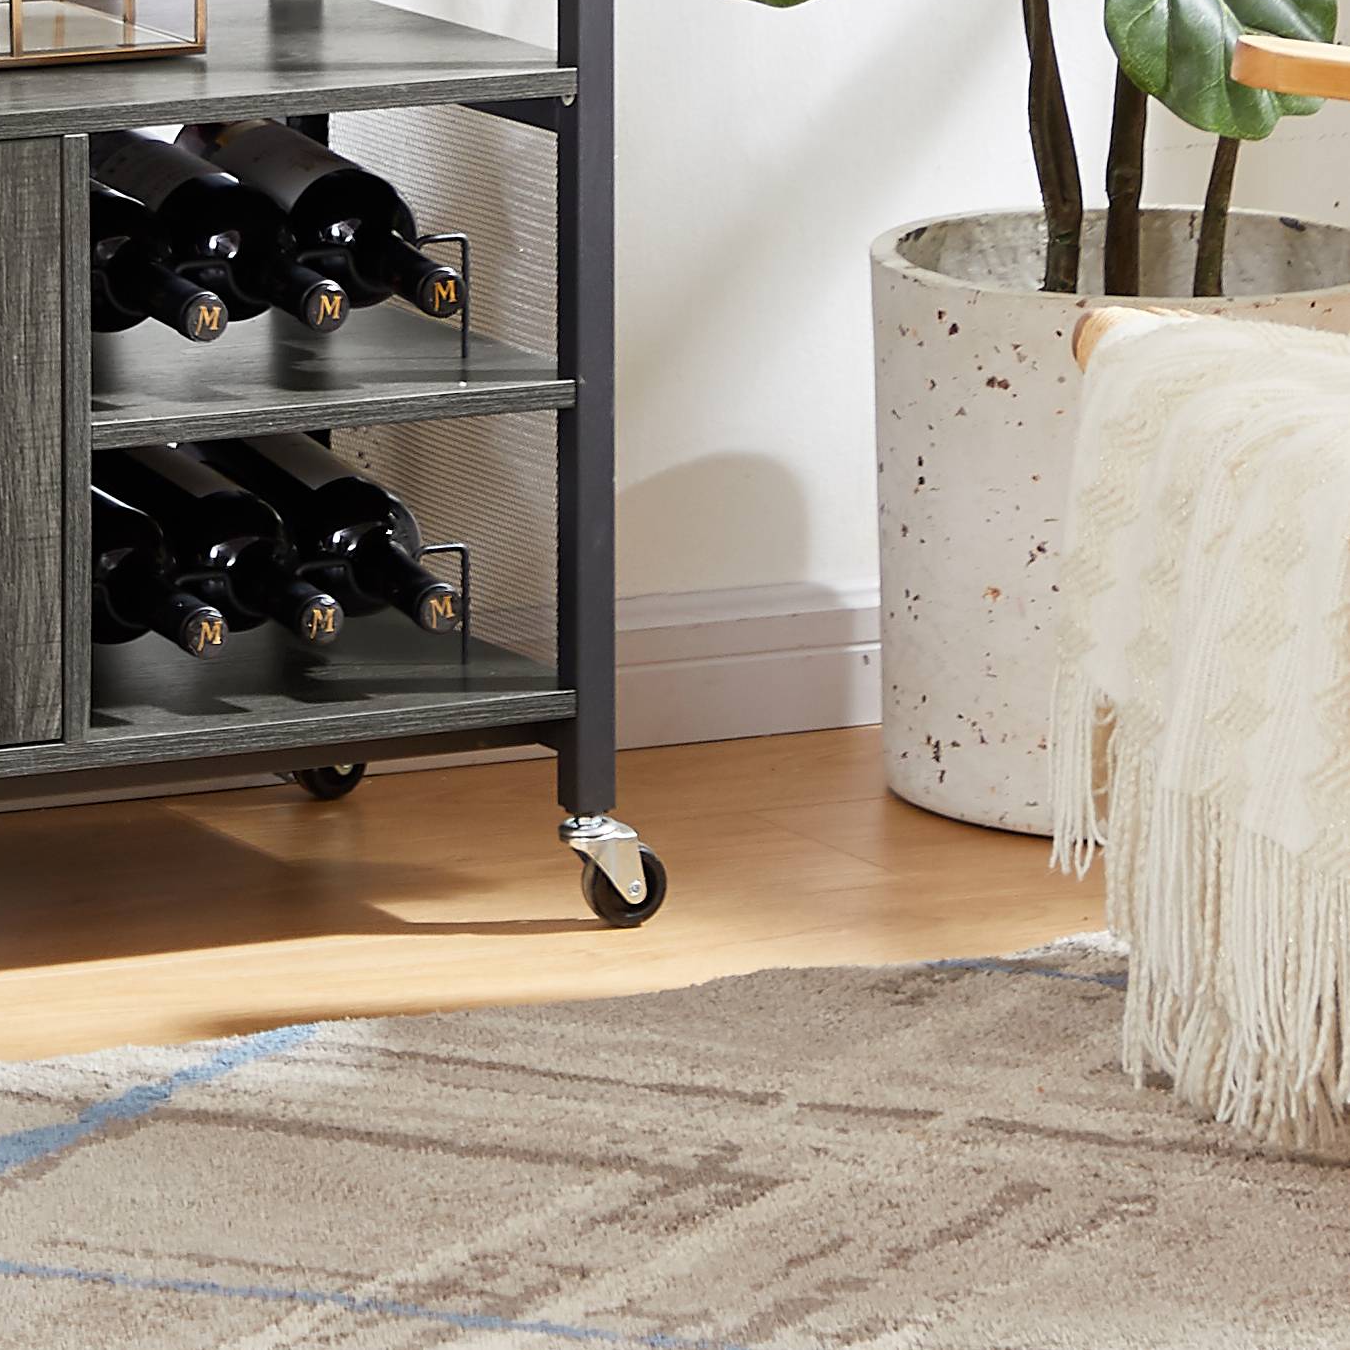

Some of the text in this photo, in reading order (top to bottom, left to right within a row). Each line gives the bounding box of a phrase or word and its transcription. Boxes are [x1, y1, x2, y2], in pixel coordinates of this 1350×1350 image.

[315, 294, 344, 326] M
[432, 279, 458, 311] M
[194, 305, 222, 337] M
[308, 608, 336, 641] M
[428, 596, 455, 630] M
[196, 620, 223, 653] M
